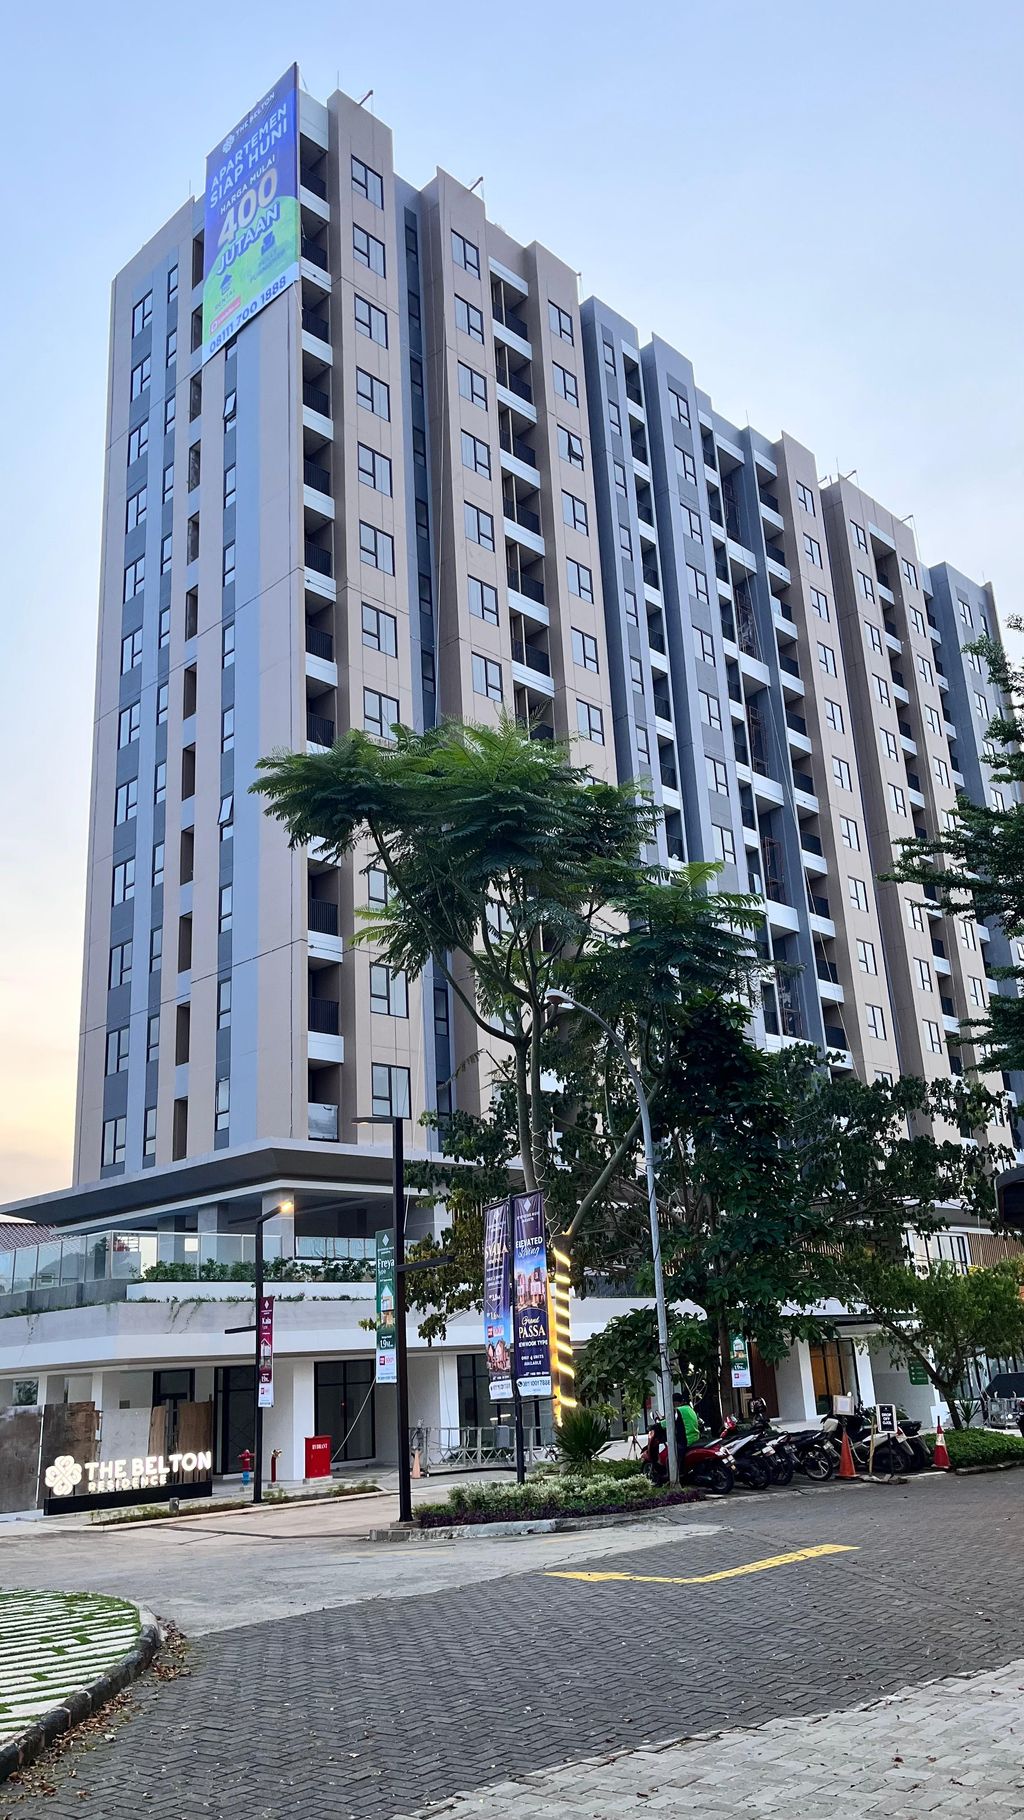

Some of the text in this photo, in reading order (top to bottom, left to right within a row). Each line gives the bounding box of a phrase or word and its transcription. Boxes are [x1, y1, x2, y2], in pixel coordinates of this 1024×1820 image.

[236, 92, 275, 137] THE BELTON
[210, 118, 287, 208] SIAP HUNI
[211, 103, 287, 191] APARTEMEN
[220, 154, 275, 216] HARGA MULAI
[218, 168, 277, 248] 400
[216, 202, 279, 275] JUTAAN
[209, 324, 235, 353] 08111
[236, 301, 258, 328] 700
[260, 276, 287, 305] 1888
[377, 1258, 395, 1270] Freya
[515, 1236, 543, 1249] ELEVATED
[519, 1325, 546, 1338] PASSA
[521, 1315, 540, 1326] Grand
[85, 1450, 212, 1481] THE BELTON
[87, 1474, 167, 1493] RESIDENCE
